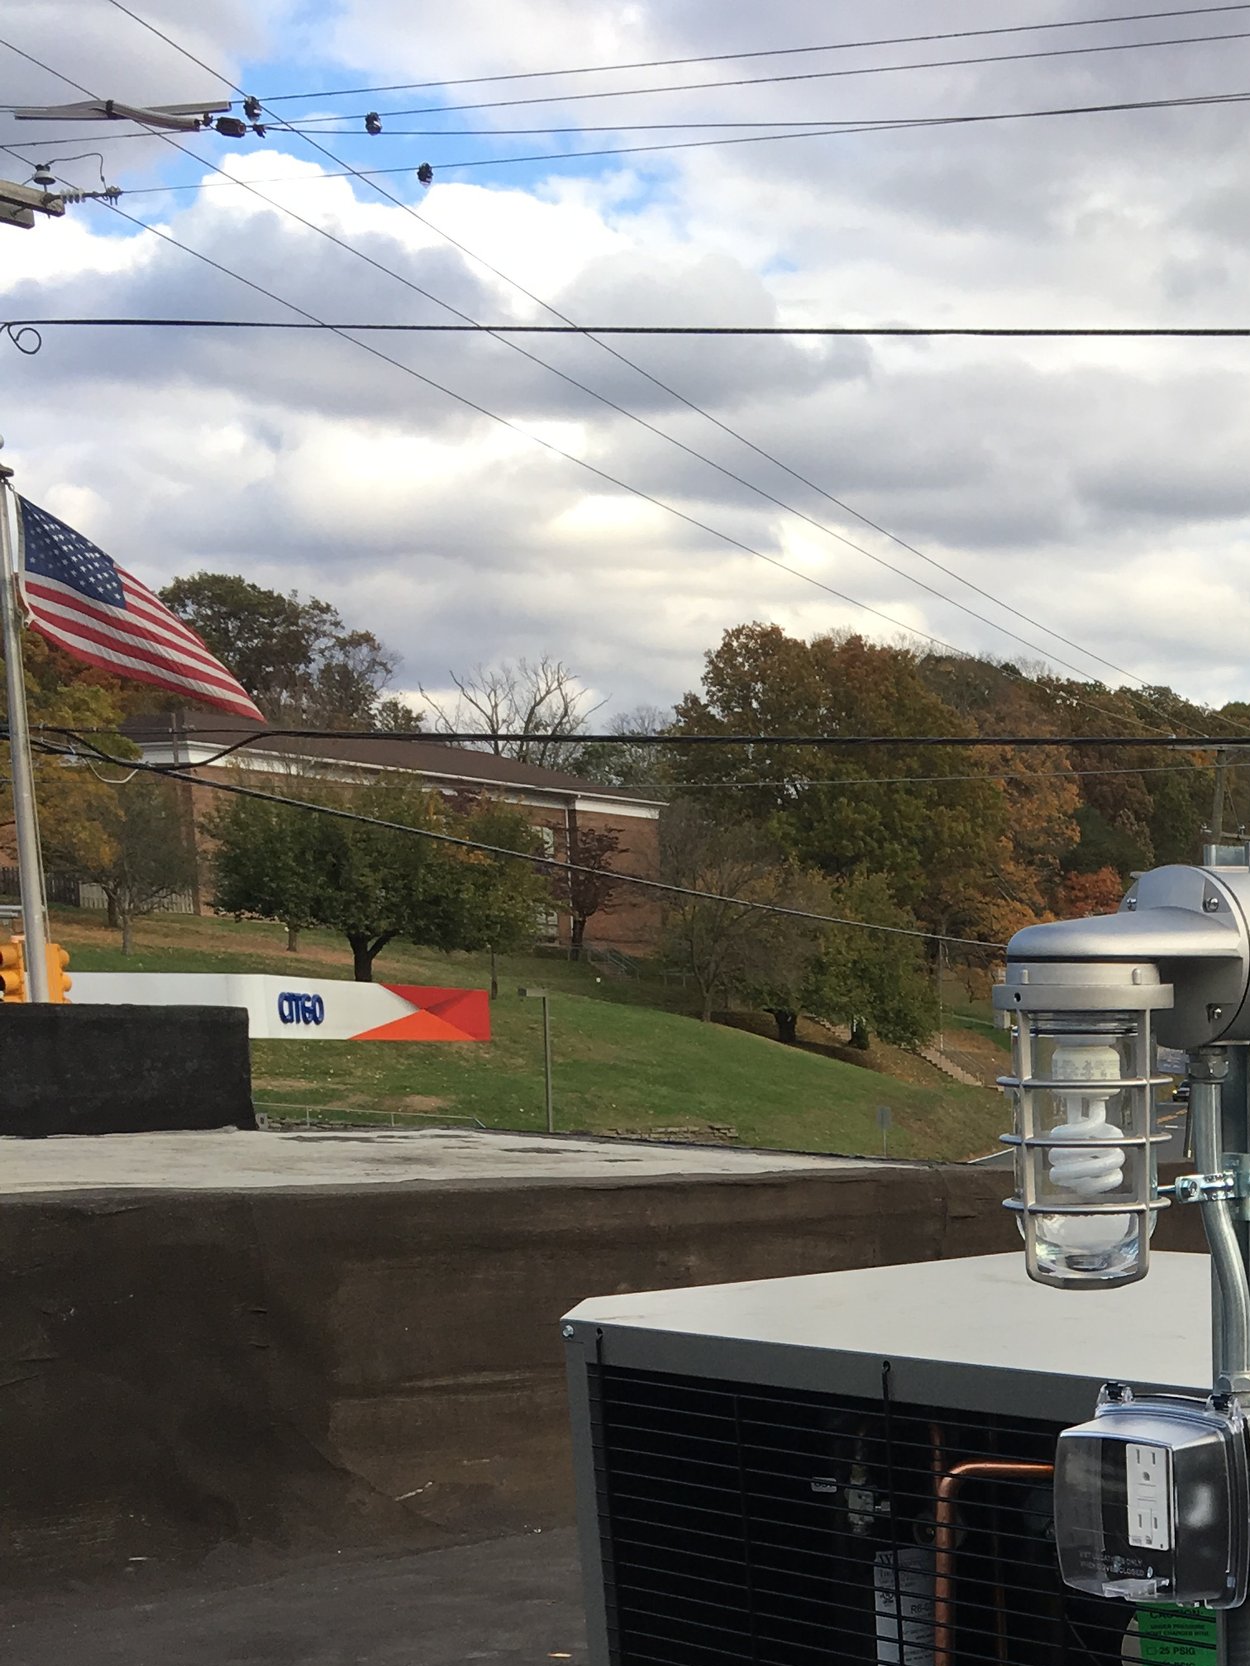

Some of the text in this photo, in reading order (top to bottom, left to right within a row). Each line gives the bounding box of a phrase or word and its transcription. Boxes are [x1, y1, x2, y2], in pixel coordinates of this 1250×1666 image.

[278, 991, 324, 1026] CITGO
[1160, 1646, 1196, 1656] 25 PSIG
